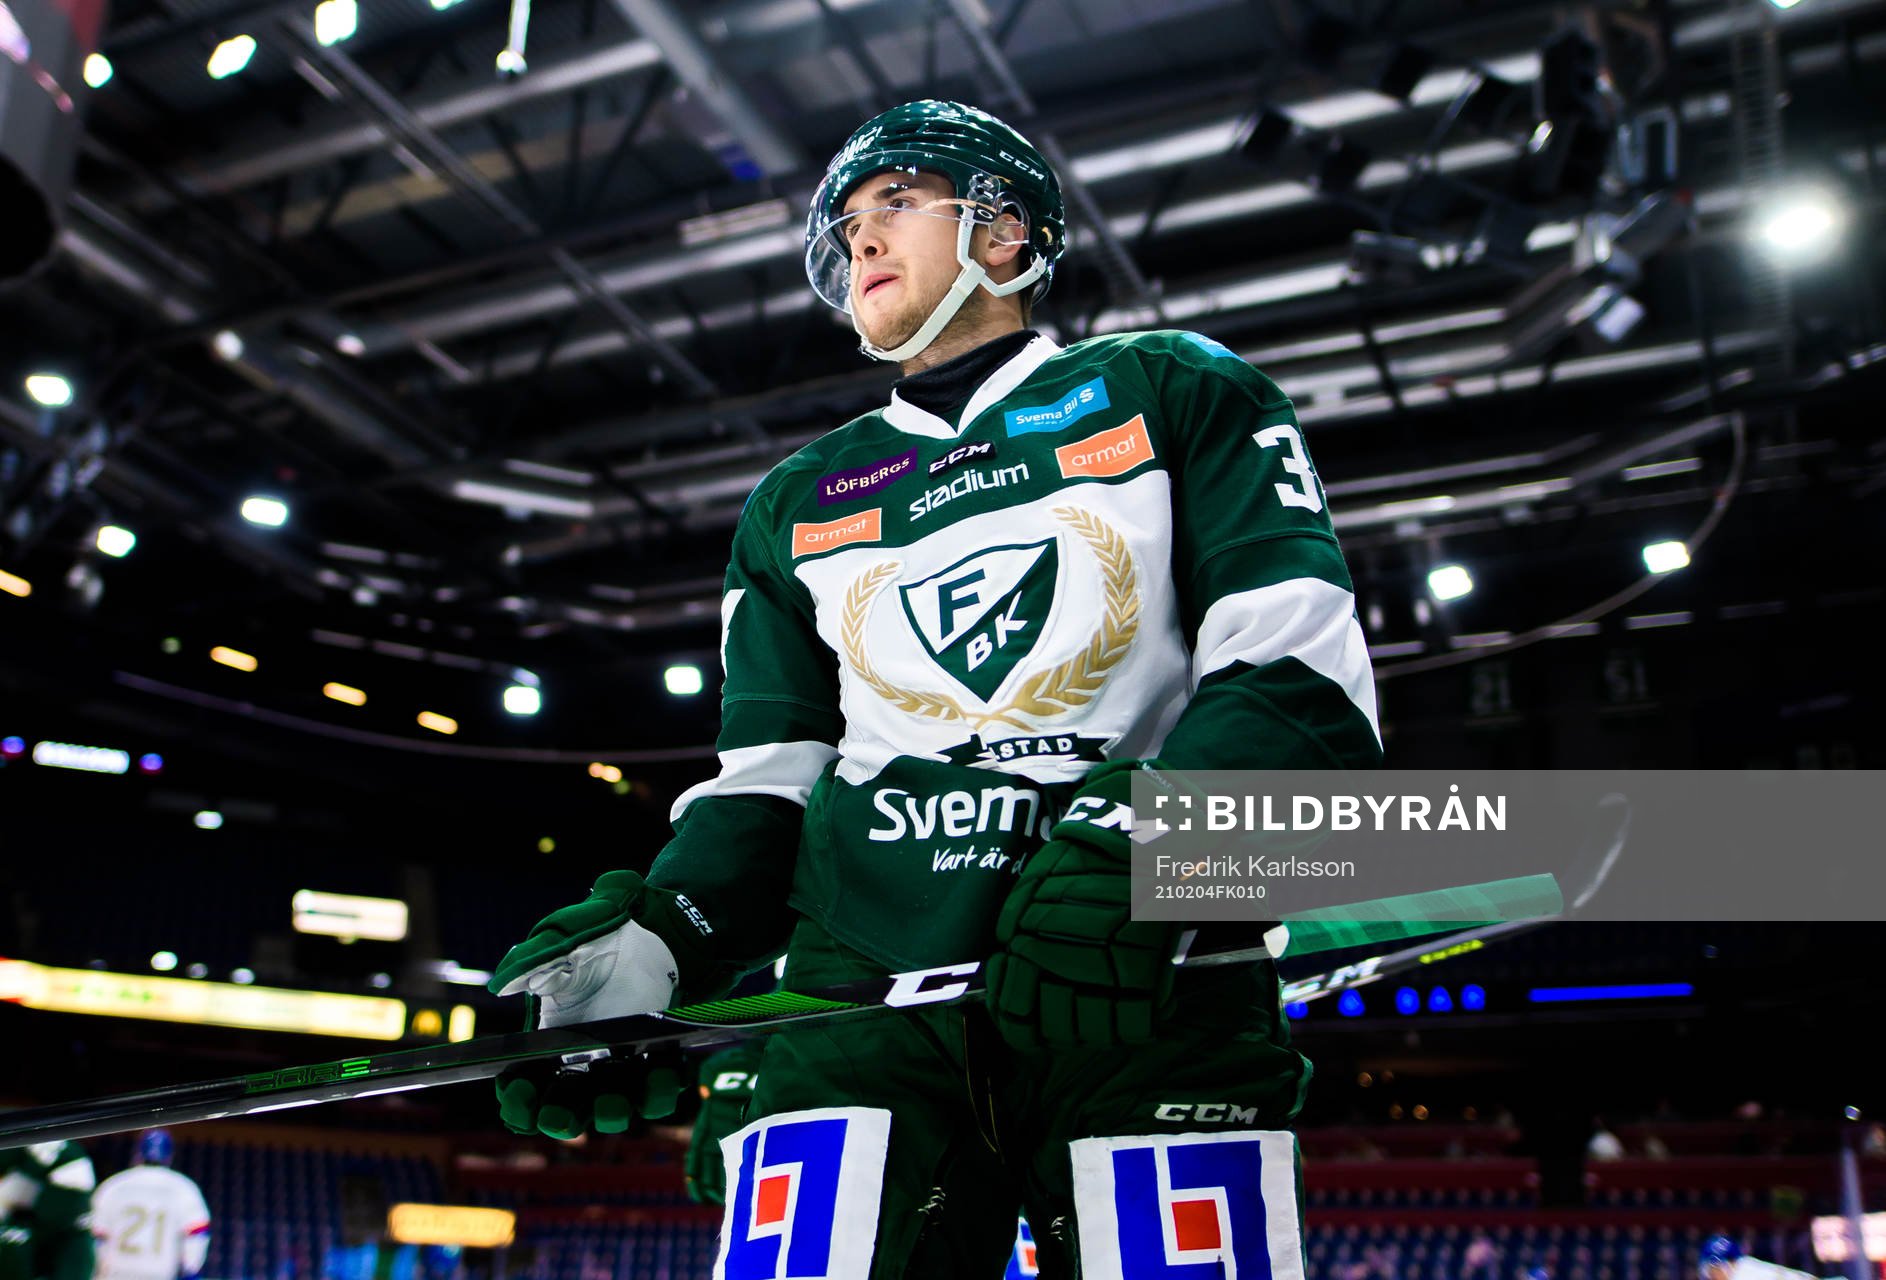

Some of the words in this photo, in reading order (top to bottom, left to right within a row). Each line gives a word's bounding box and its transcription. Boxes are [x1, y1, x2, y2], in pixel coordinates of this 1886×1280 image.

[999, 150, 1044, 180] CCM
[1016, 411, 1062, 425] Svema
[929, 442, 992, 474] CCM
[1072, 433, 1138, 467] armat
[827, 457, 910, 496] LÖFBERGS
[910, 462, 1029, 522] stadium
[805, 519, 871, 543] armat
[979, 847, 1010, 869] är
[676, 894, 713, 933] CCM
[1154, 1103, 1258, 1124] CCM
[119, 1206, 166, 1254] 21
